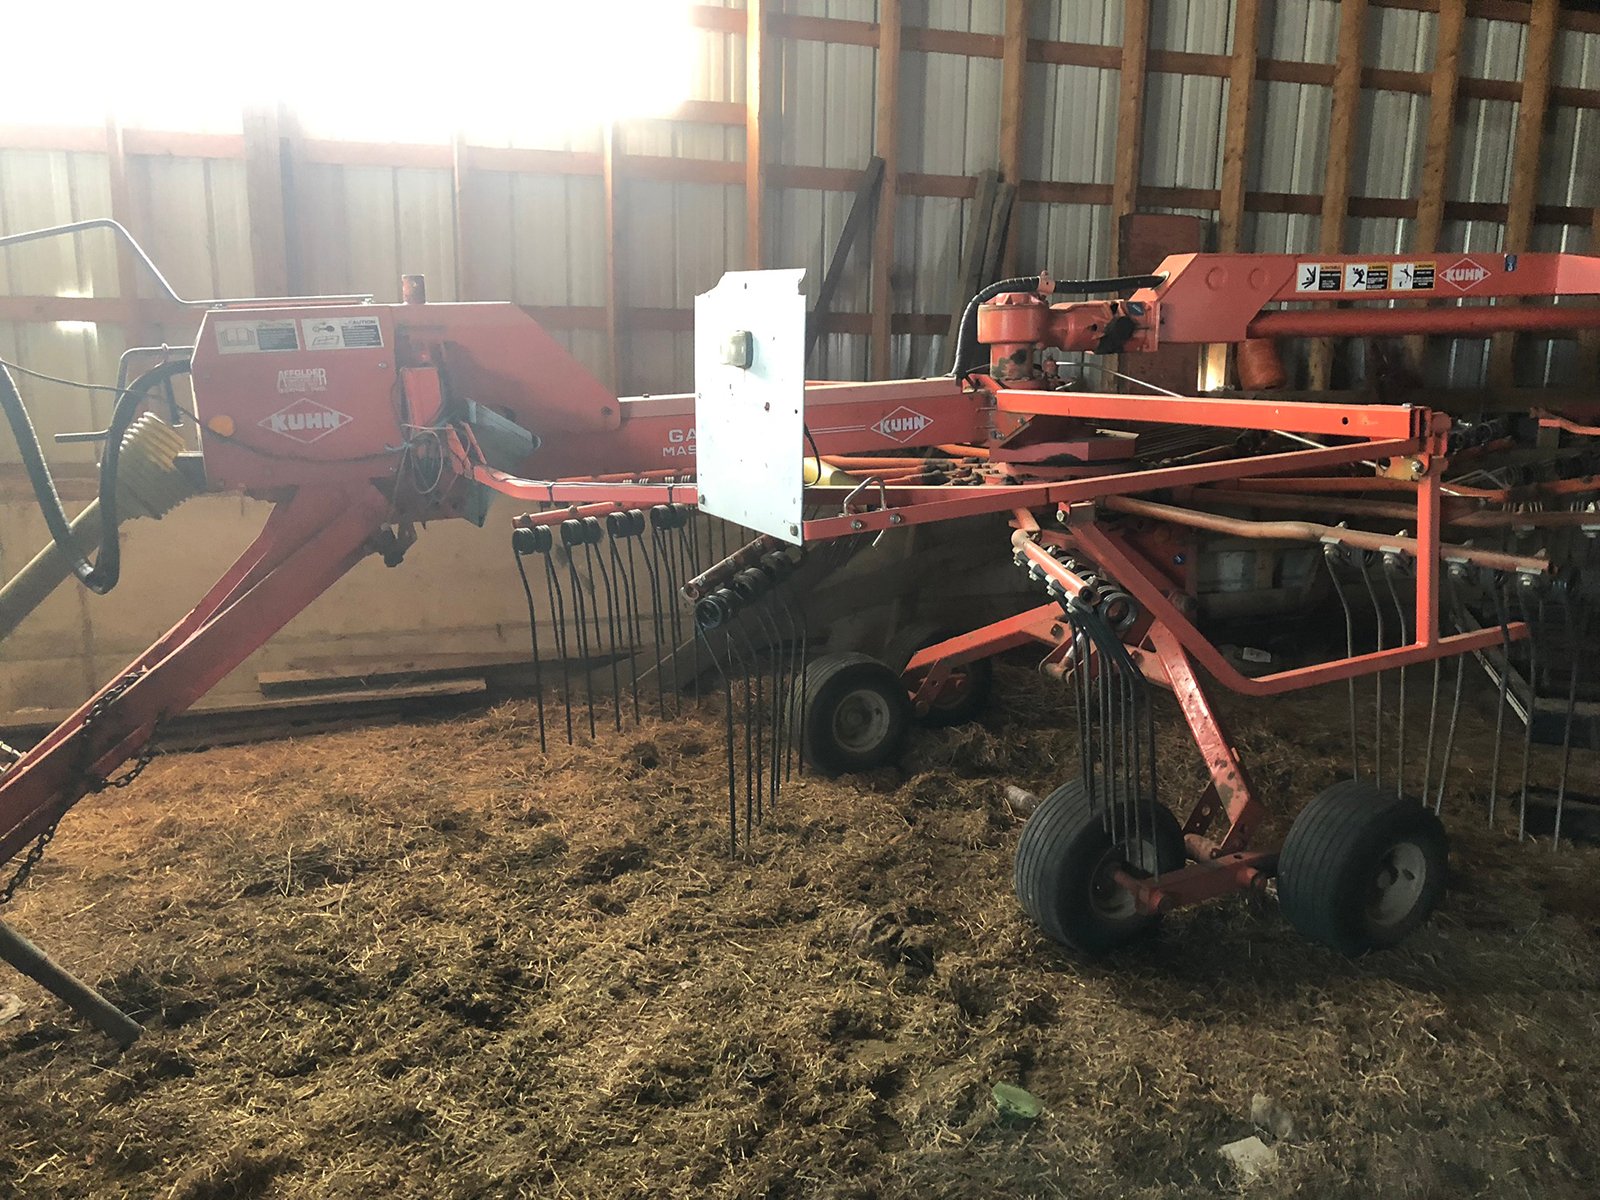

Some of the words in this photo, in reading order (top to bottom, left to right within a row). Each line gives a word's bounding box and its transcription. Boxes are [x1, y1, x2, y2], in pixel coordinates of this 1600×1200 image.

[1446, 268, 1485, 281] KUHN
[271, 410, 340, 433] KUHN
[880, 415, 925, 433] KUHN
